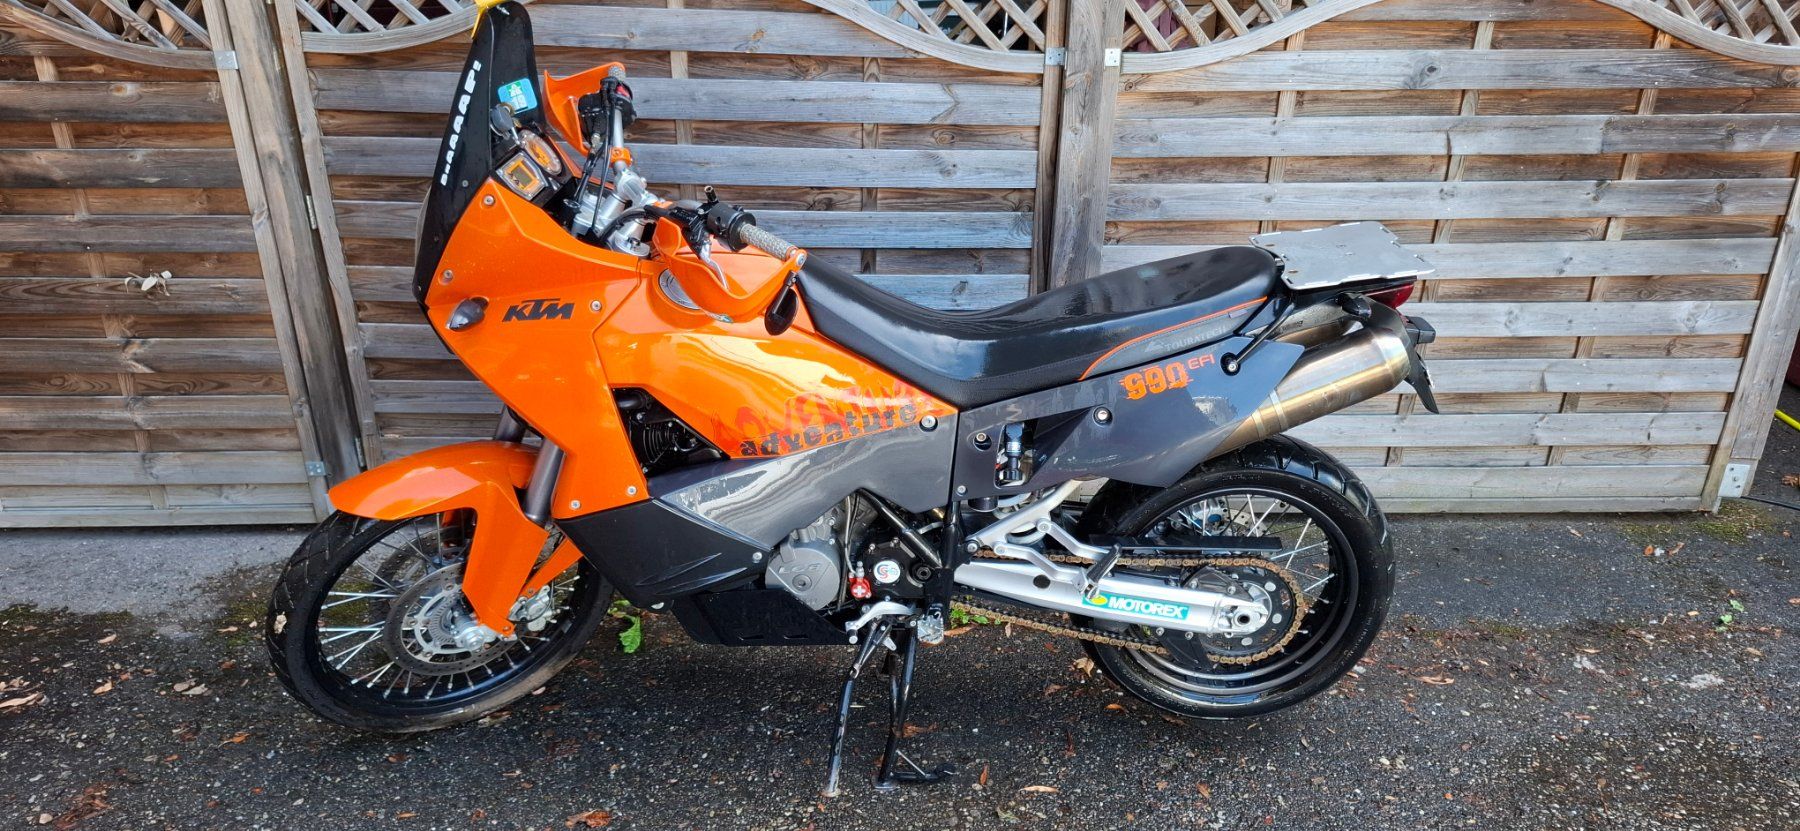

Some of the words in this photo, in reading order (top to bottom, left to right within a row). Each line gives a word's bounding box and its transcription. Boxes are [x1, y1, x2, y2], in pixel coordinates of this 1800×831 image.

[502, 298, 575, 322] KTM
[1163, 325, 1228, 352] TOURATECH
[1120, 361, 1192, 400] 990
[1187, 353, 1215, 370] EFI
[740, 403, 917, 457] adventure
[1108, 596, 1186, 619] MOTOREX
